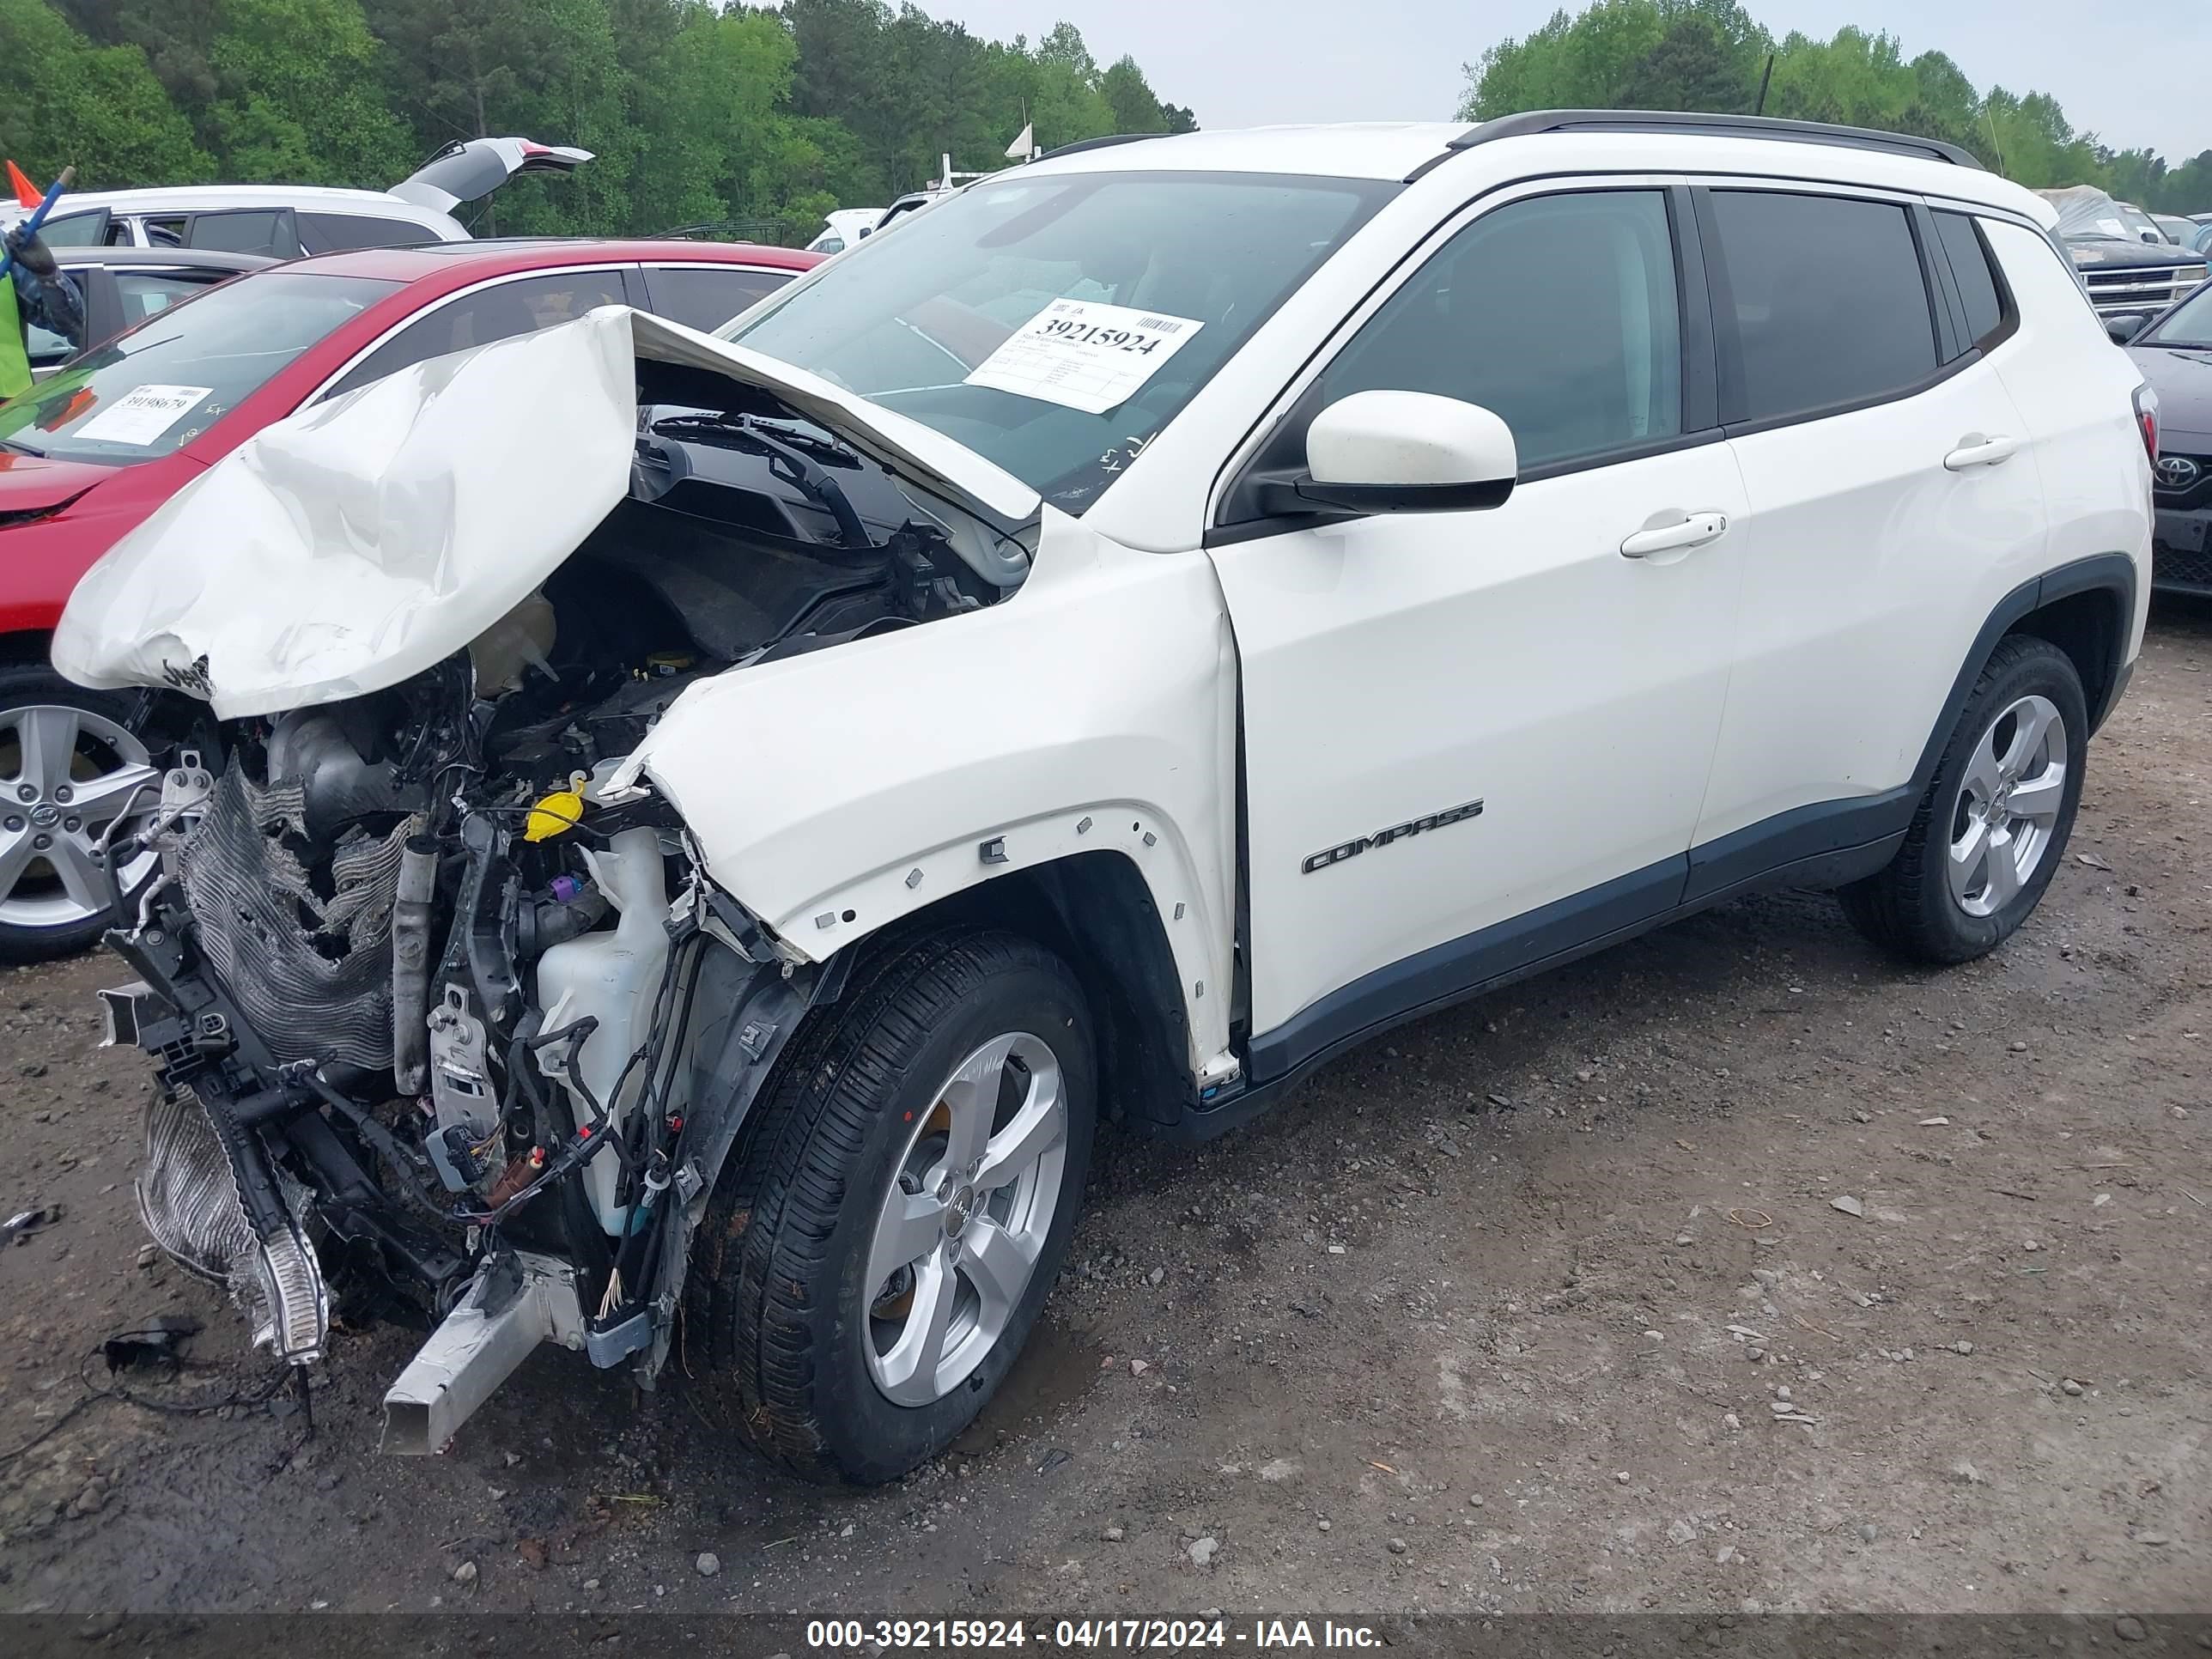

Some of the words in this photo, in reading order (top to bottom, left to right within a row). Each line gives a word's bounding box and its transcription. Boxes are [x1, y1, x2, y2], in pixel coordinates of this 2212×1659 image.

[1036, 319, 1161, 355] 39215924
[121, 396, 187, 410] 39198679
[1302, 797, 1485, 874] COMPASS
